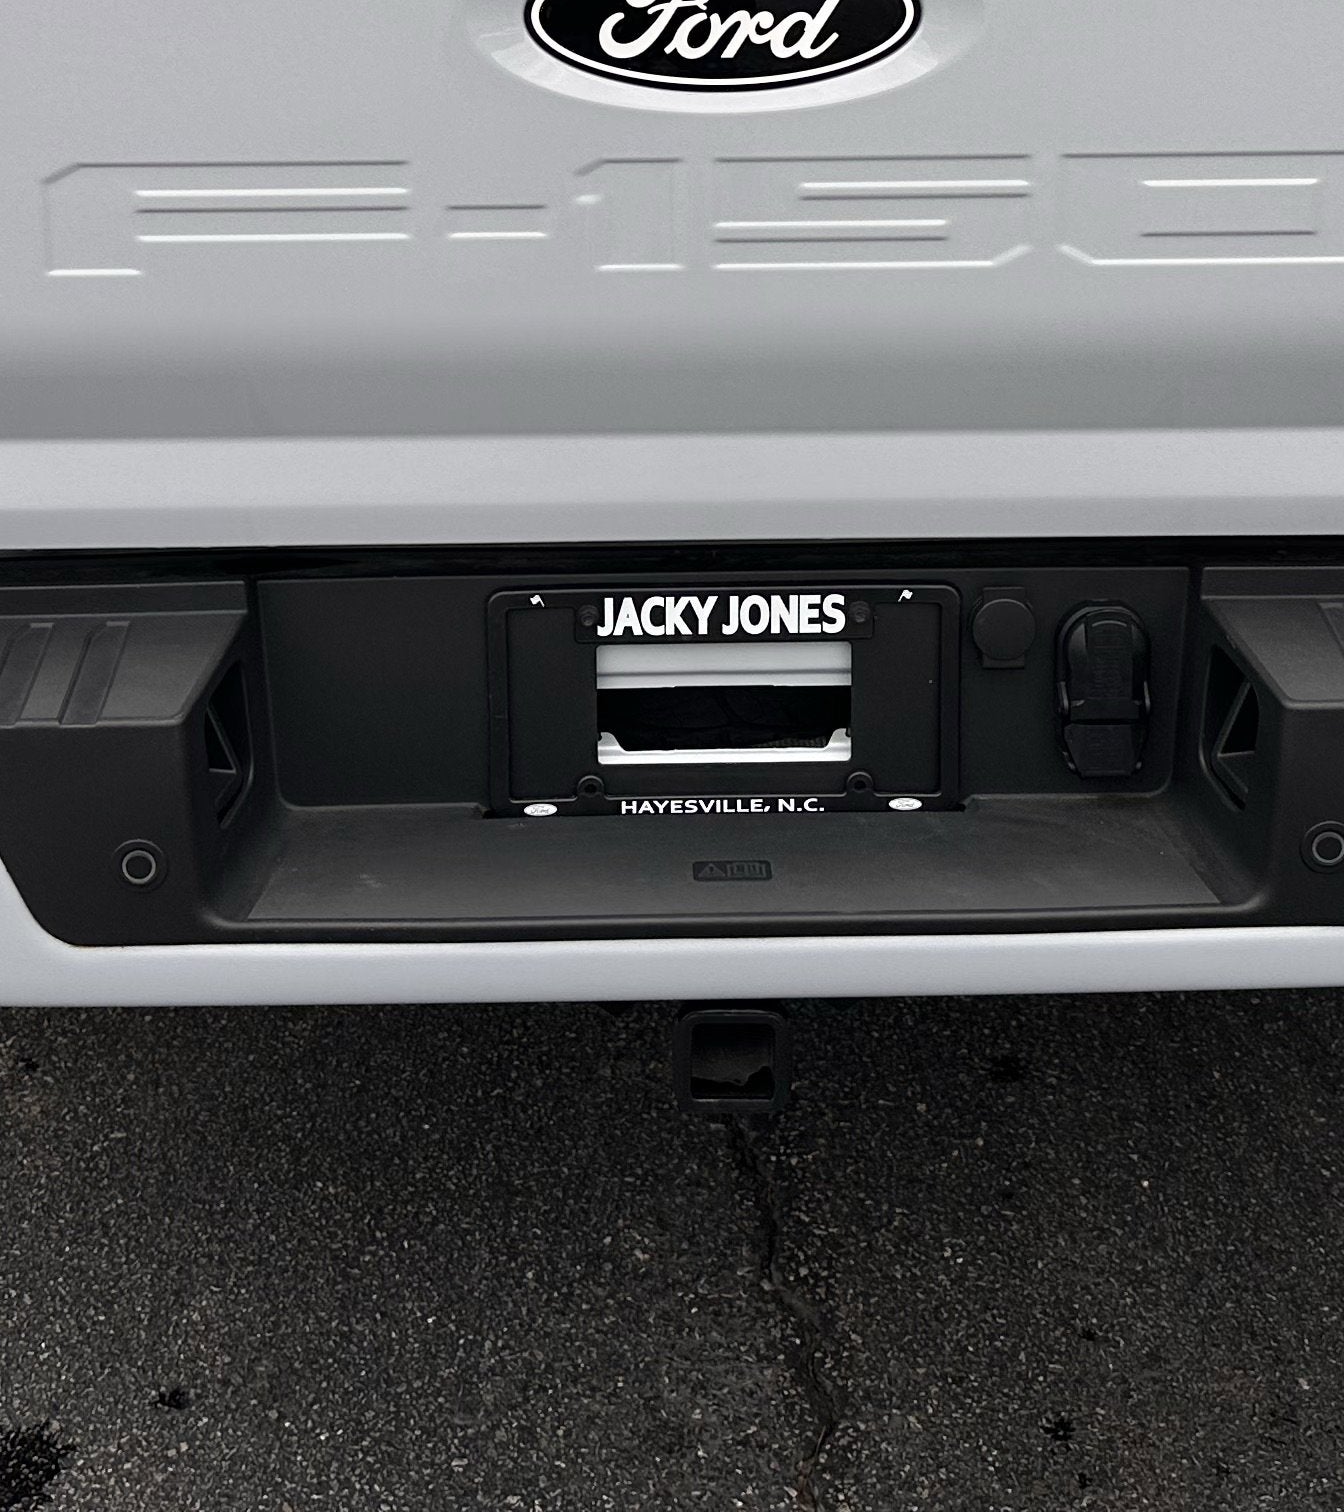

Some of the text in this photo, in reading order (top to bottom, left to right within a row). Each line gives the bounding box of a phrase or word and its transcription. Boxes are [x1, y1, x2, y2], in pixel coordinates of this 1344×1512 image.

[597, 594, 846, 636] JACKY JONES
[621, 798, 825, 814] HAYESVILLE, N.C.
